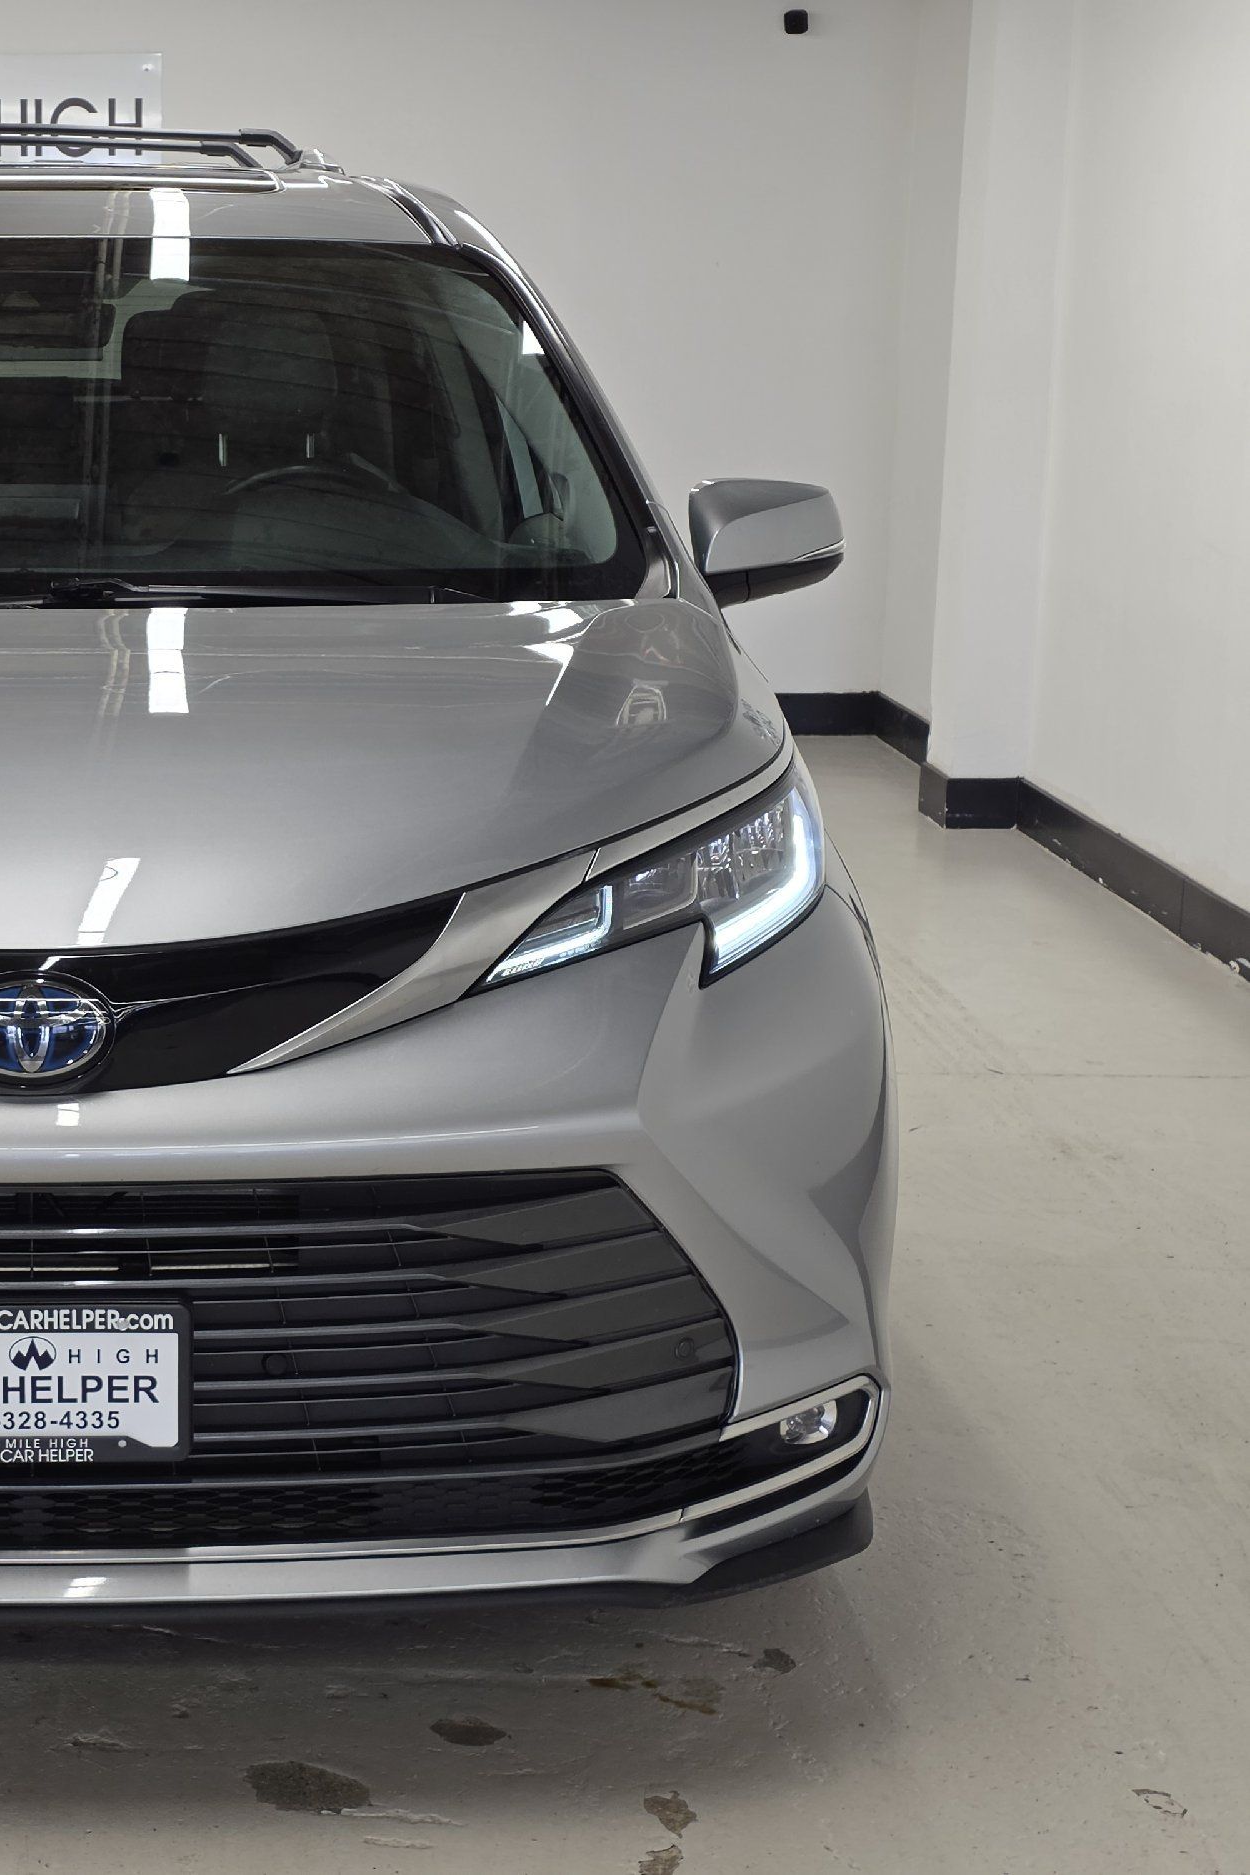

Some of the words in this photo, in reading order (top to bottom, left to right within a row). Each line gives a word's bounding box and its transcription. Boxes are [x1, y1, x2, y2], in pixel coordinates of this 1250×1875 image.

[68, 1348, 159, 1364] HIGH
[2, 1375, 160, 1404] HELPER
[5, 1438, 41, 1449] MILE
[49, 1438, 89, 1448] HIGH
[0, 1449, 35, 1463] CAR
[38, 1448, 94, 1462] HELPER
